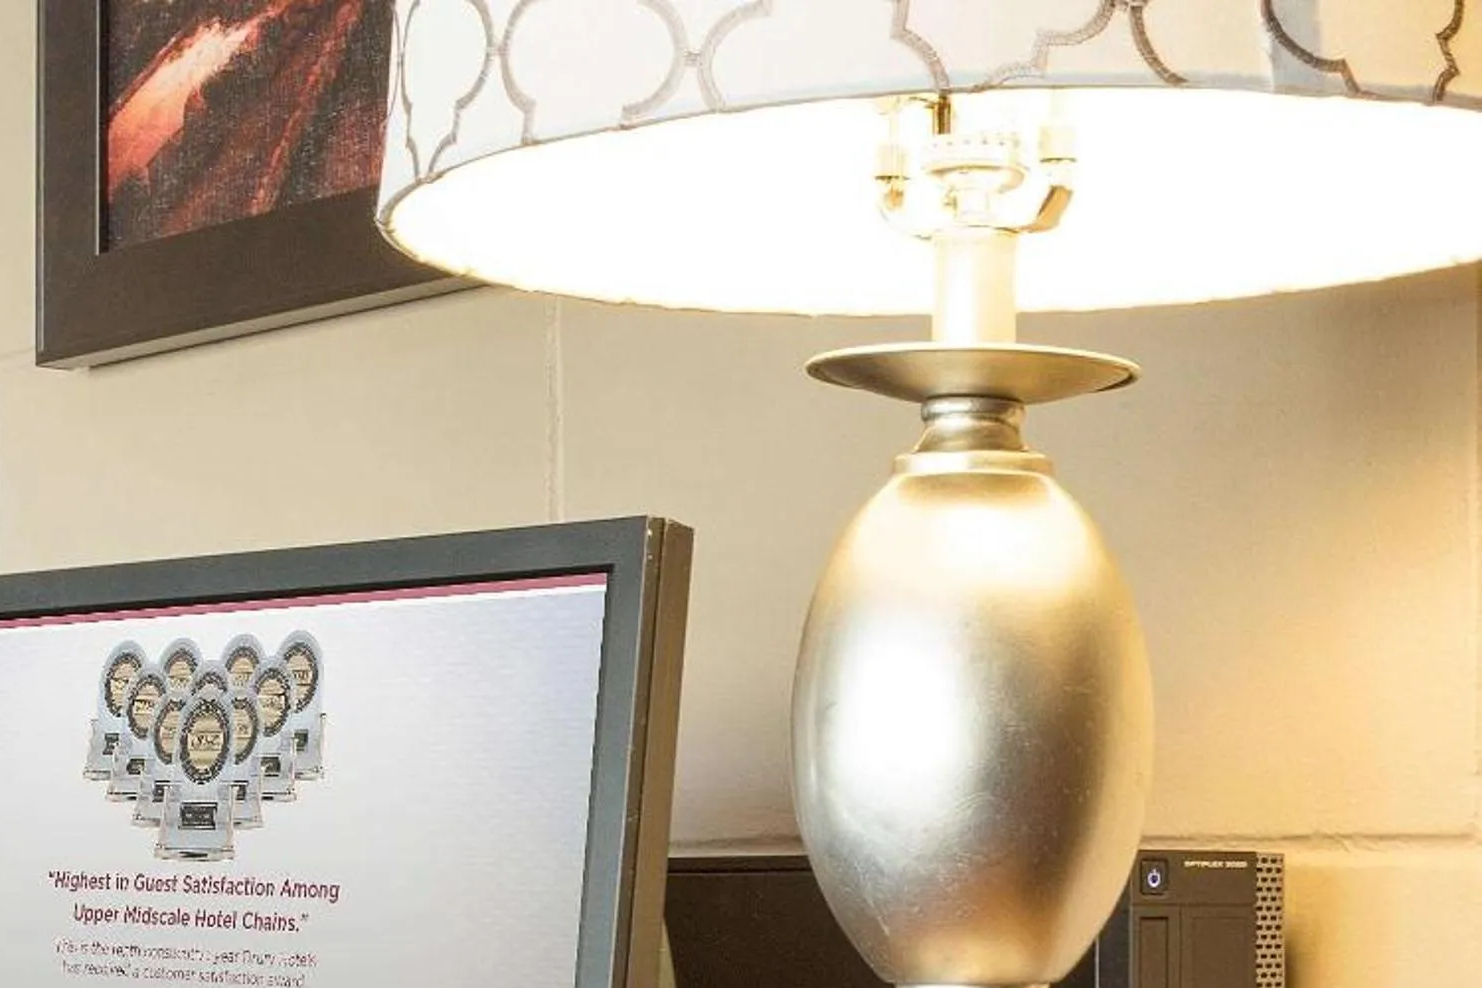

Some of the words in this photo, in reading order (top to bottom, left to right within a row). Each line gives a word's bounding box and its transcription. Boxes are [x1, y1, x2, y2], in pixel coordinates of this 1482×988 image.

[115, 872, 130, 891] in
[133, 873, 178, 893] Guest
[182, 875, 275, 898] Satisfaction
[280, 878, 341, 903] Among
[73, 903, 120, 925] Upper
[124, 905, 191, 926] Midscale
[195, 909, 238, 930] Hotel
[143, 967, 195, 981] customer
[198, 968, 264, 986] satisfaction
